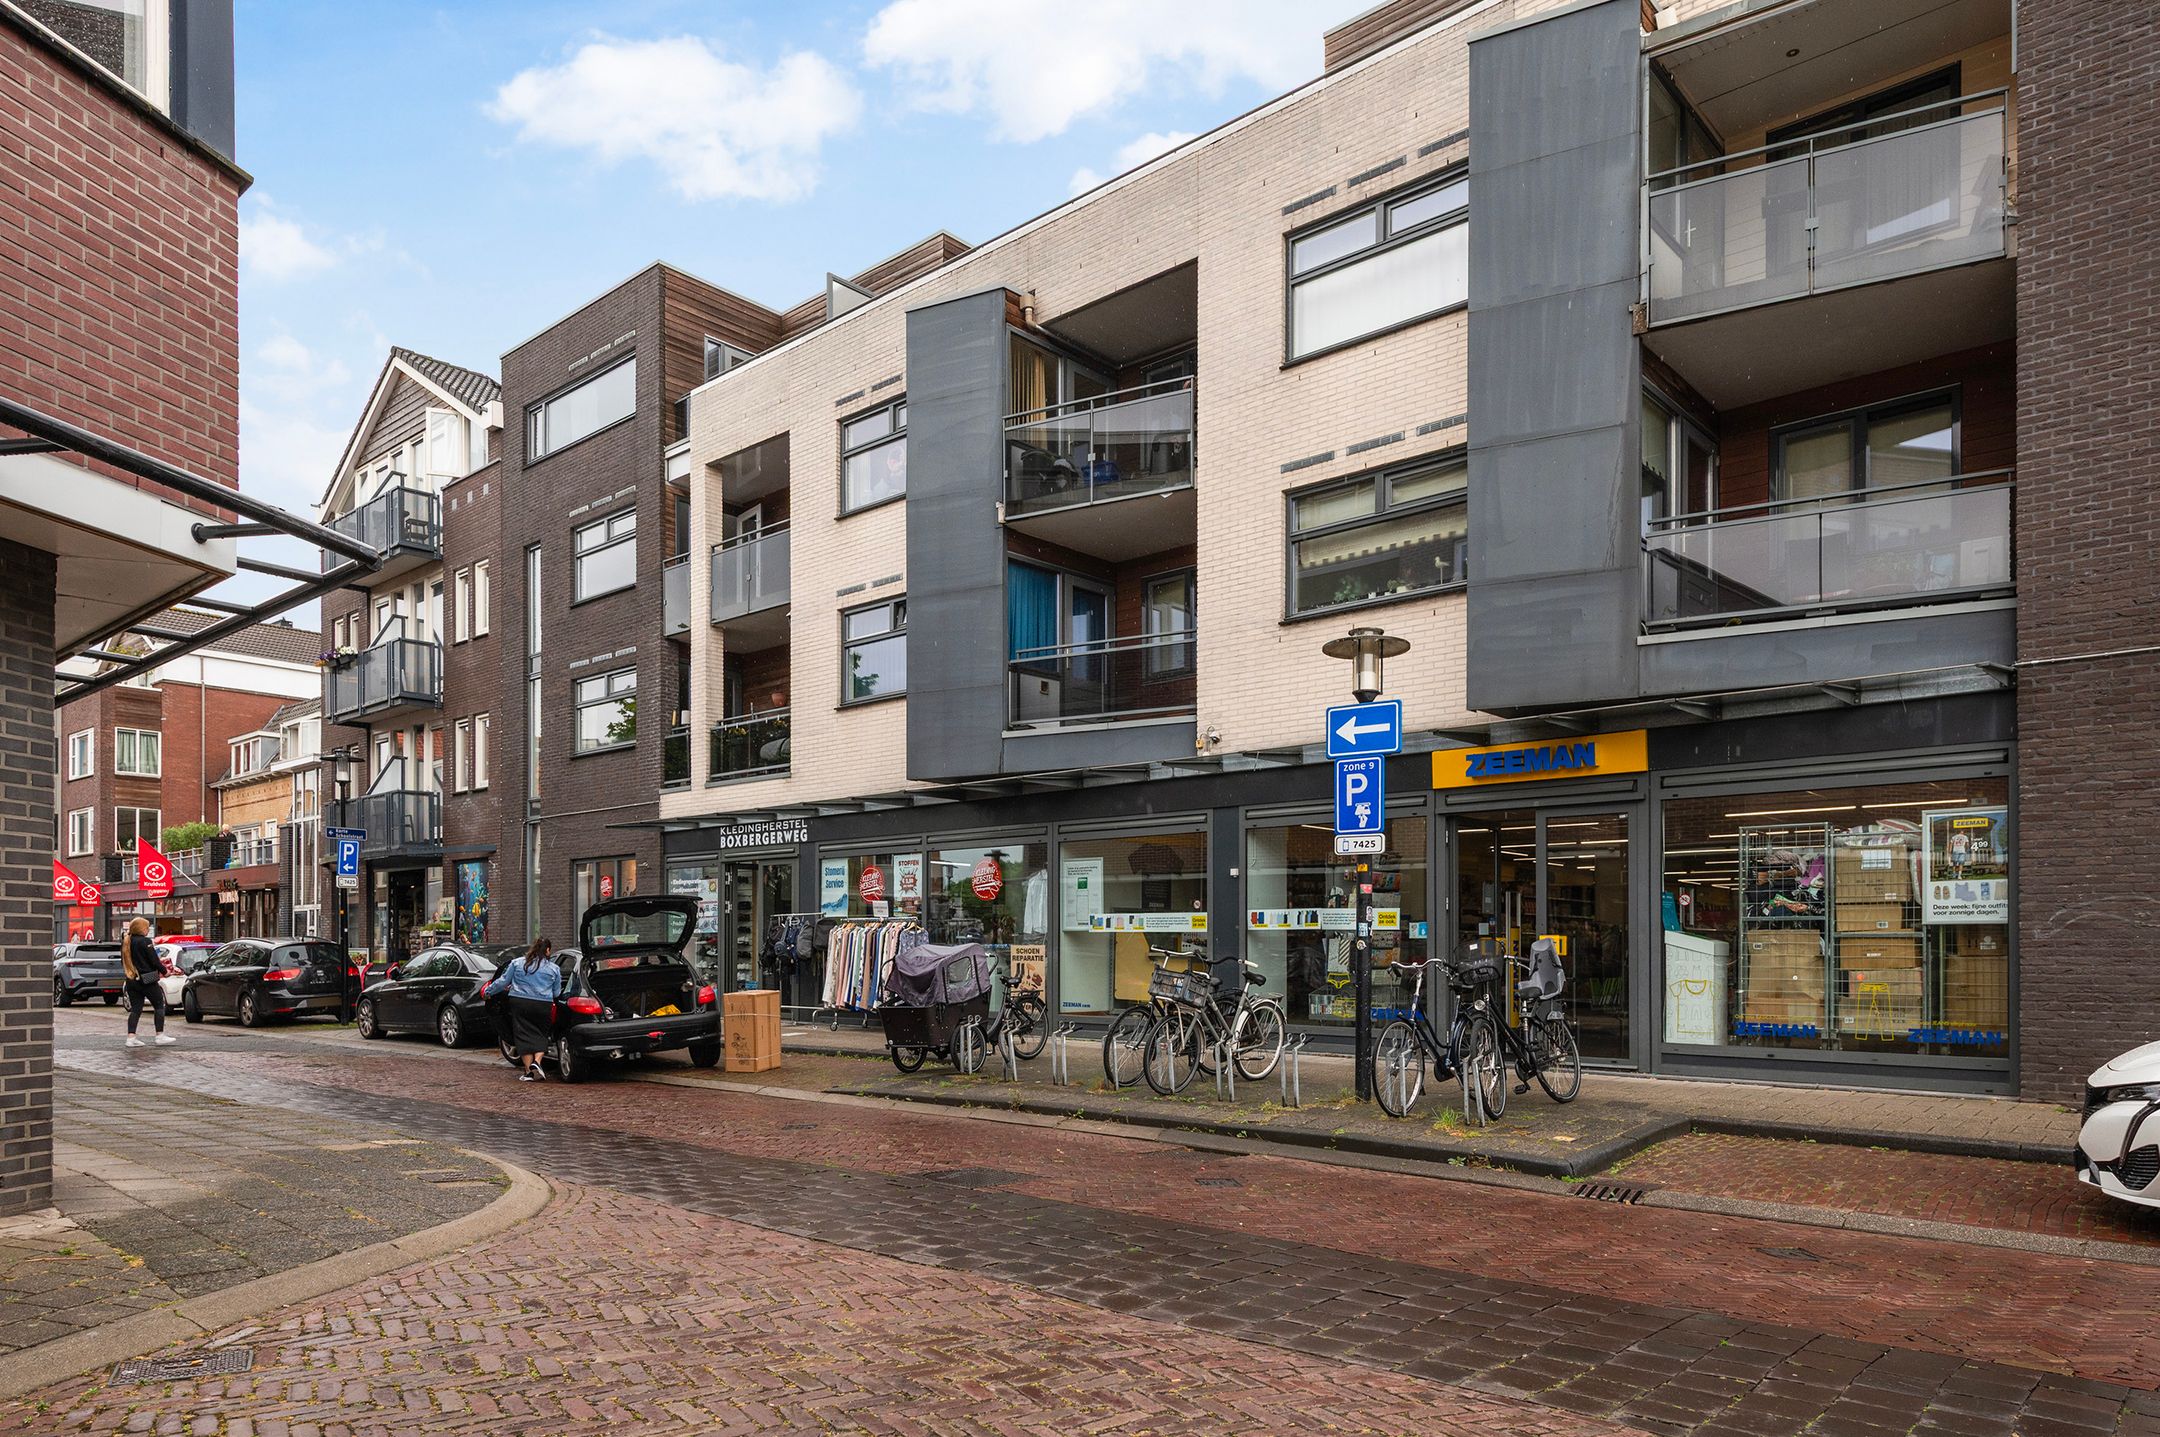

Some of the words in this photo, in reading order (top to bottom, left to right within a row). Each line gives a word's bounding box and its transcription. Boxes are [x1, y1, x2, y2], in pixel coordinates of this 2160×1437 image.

[1343, 762, 1366, 772] zone
[1368, 761, 1375, 770] 9
[1465, 742, 1595, 777] ZEEMAN
[1346, 773, 1368, 807] P
[720, 819, 808, 836] KLEDINGHERSTEL
[720, 829, 808, 849] BOXBERGERWEG
[1353, 840, 1376, 849] 7425
[343, 843, 355, 861] P
[898, 859, 920, 867] STOFFEN
[825, 879, 844, 888] Service
[1971, 903, 1987, 911] fijne
[1734, 1022, 1816, 1039] ZEEMAN
[1907, 1028, 2002, 1046] ZEEMAN
